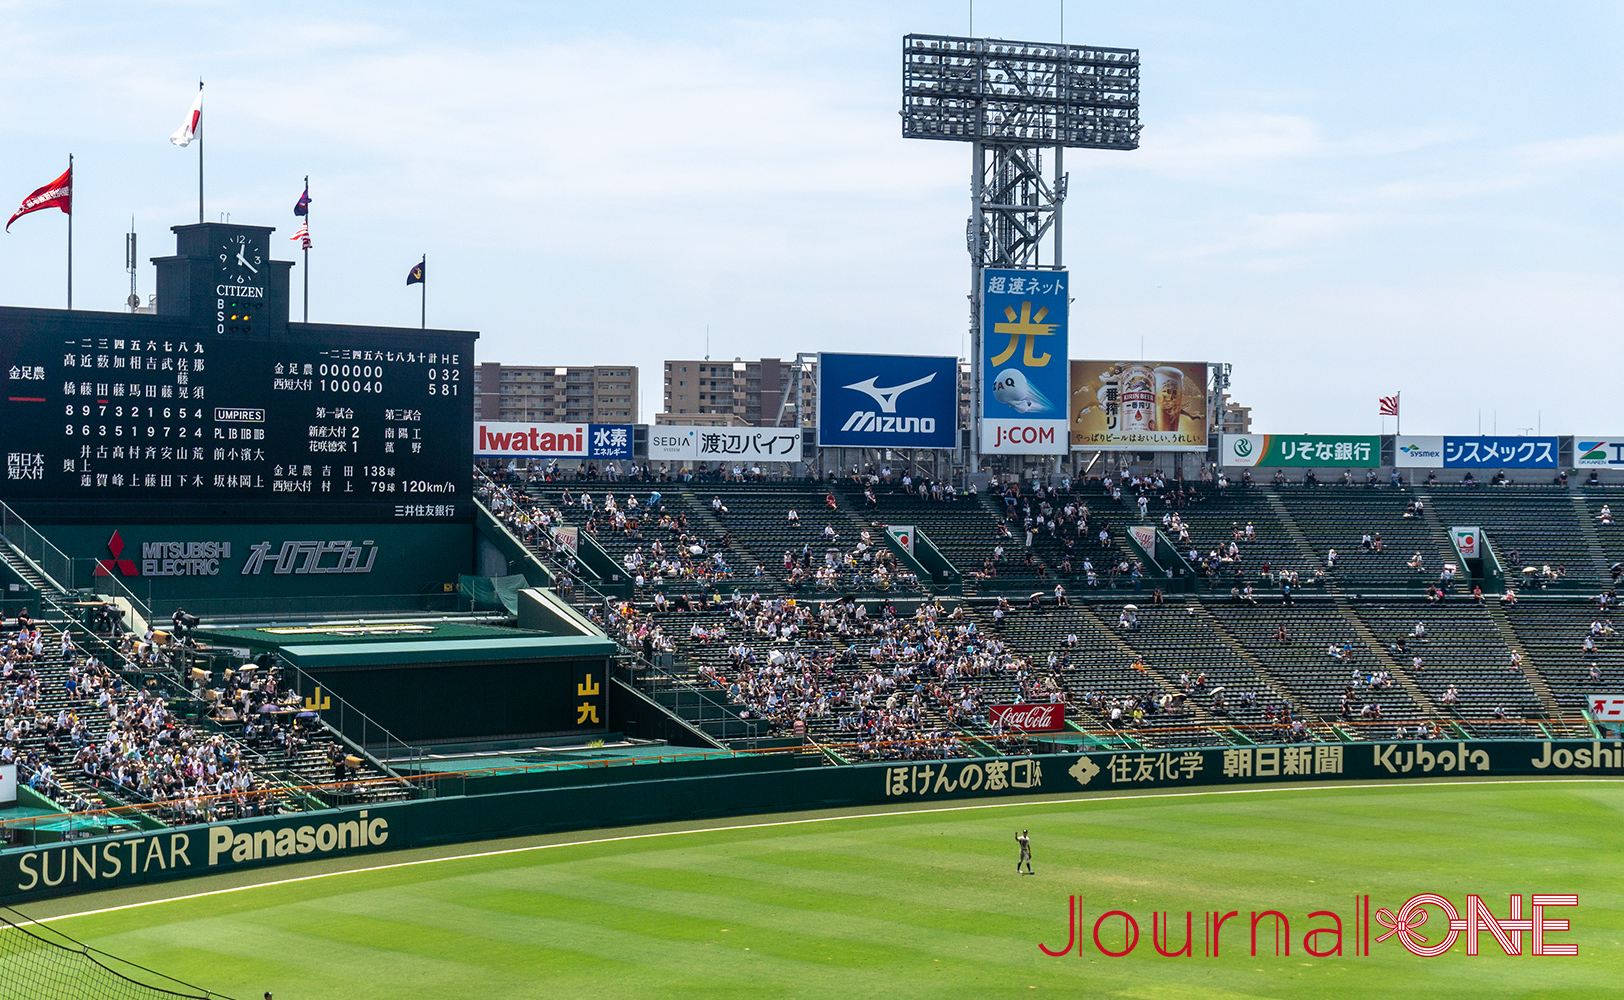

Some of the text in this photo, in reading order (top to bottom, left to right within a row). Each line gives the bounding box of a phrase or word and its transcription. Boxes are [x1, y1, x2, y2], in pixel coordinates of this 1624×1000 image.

[236, 234, 246, 244] 12
[220, 253, 262, 265] 9 3
[236, 274, 244, 284] 6
[987, 276, 1064, 296] 超速ネット
[216, 284, 264, 298] CITIZEN
[217, 298, 225, 310] B
[217, 311, 225, 322] S
[990, 301, 1062, 368] 光
[82, 338, 92, 348] 二
[98, 338, 108, 348] 三
[114, 339, 124, 350] 四
[130, 340, 140, 350] 五
[146, 340, 156, 351] 六
[163, 341, 172, 352] 七
[178, 342, 188, 352] 八
[194, 342, 204, 354] 九
[9, 365, 45, 380] 金足農
[274, 378, 312, 391] 西短大付
[66, 405, 202, 418] 8 9 7 3 2 1 6 5 4
[316, 406, 422, 421] 第一試合 第三試合
[1106, 382, 1118, 430] 一番搾り
[218, 410, 262, 420] UMPIRES
[841, 411, 936, 434] MIZUNO
[66, 425, 202, 438] 8 6 3 5 1 9 7 2 4
[214, 428, 225, 439] PL
[352, 426, 360, 438] 2
[480, 426, 583, 452] Iwatani
[594, 428, 627, 448] 水素
[994, 426, 1054, 448] J:COM
[352, 441, 358, 453] 1
[653, 436, 690, 446] SEDIA
[701, 432, 800, 454] 渡辺パイプ
[594, 448, 628, 456] エネルギー
[1281, 441, 1371, 461] りそな銀行
[1446, 442, 1554, 462] シスメックス
[8, 452, 44, 466] 西日本
[8, 466, 44, 480] 短大付
[272, 480, 312, 492] 西短大付
[394, 504, 455, 517] 三井住友銀行
[142, 542, 231, 559] MITSUBISHI
[142, 559, 220, 576] ELECTRIC
[577, 674, 599, 724] 山九
[1223, 746, 1344, 778] 朝日新聞
[1374, 743, 1490, 774] Kubota
[1531, 742, 1624, 770] Joshi
[1106, 751, 1204, 784] 住友化学
[208, 810, 389, 866] Panasonic
[18, 832, 192, 891] SUNSTAR
